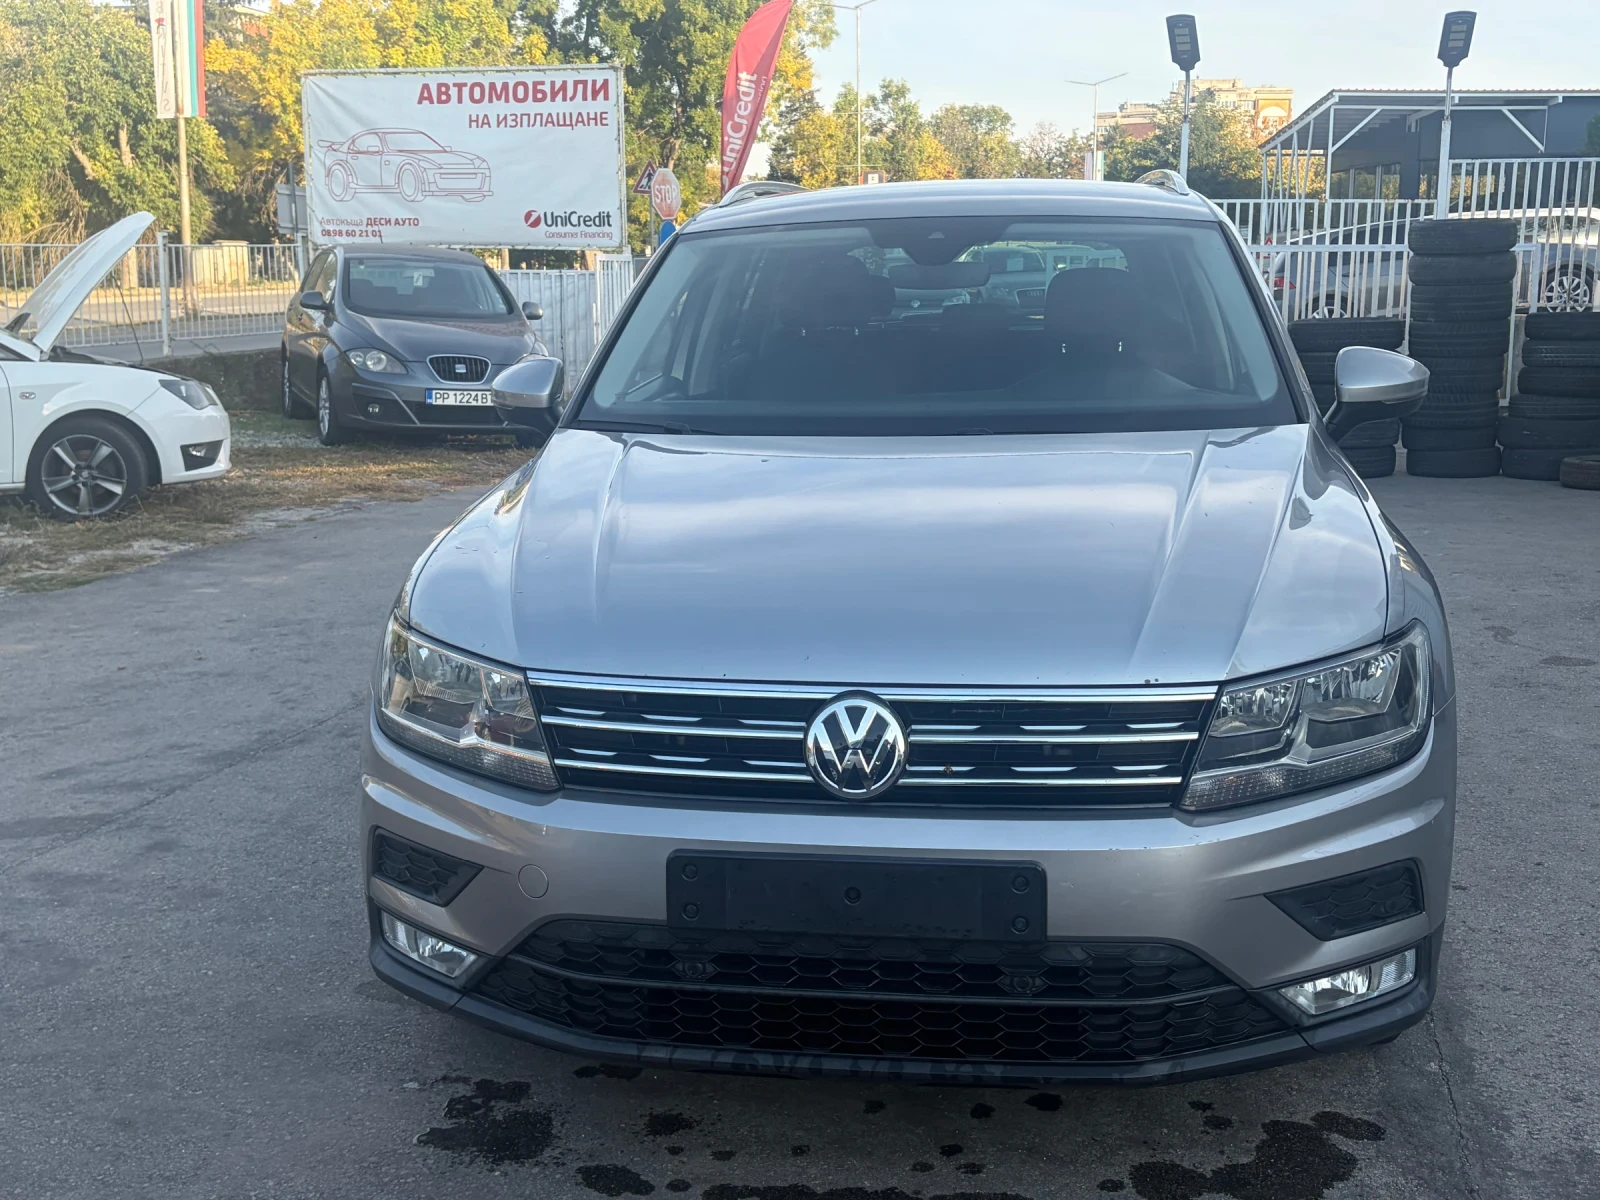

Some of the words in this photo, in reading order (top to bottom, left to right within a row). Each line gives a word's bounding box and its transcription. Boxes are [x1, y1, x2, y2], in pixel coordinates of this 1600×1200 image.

[417, 78, 610, 105] АВТОМОБИЛИ
[468, 113, 491, 129] НА
[496, 112, 609, 131] ИЗПЛАЩАНЕ
[655, 185, 677, 204] STOP
[320, 216, 363, 227] Автокъща
[366, 217, 392, 228] ДЕСИ
[394, 217, 420, 227] АУТО
[543, 210, 613, 228] UniCredit
[321, 228, 344, 237] 0898
[346, 229, 357, 237] 60
[359, 229, 370, 238] 21
[371, 229, 383, 238] 01
[545, 230, 579, 239] Consumer
[580, 230, 613, 241] Financing
[434, 392, 450, 403] PP
[453, 392, 479, 404] 1224
